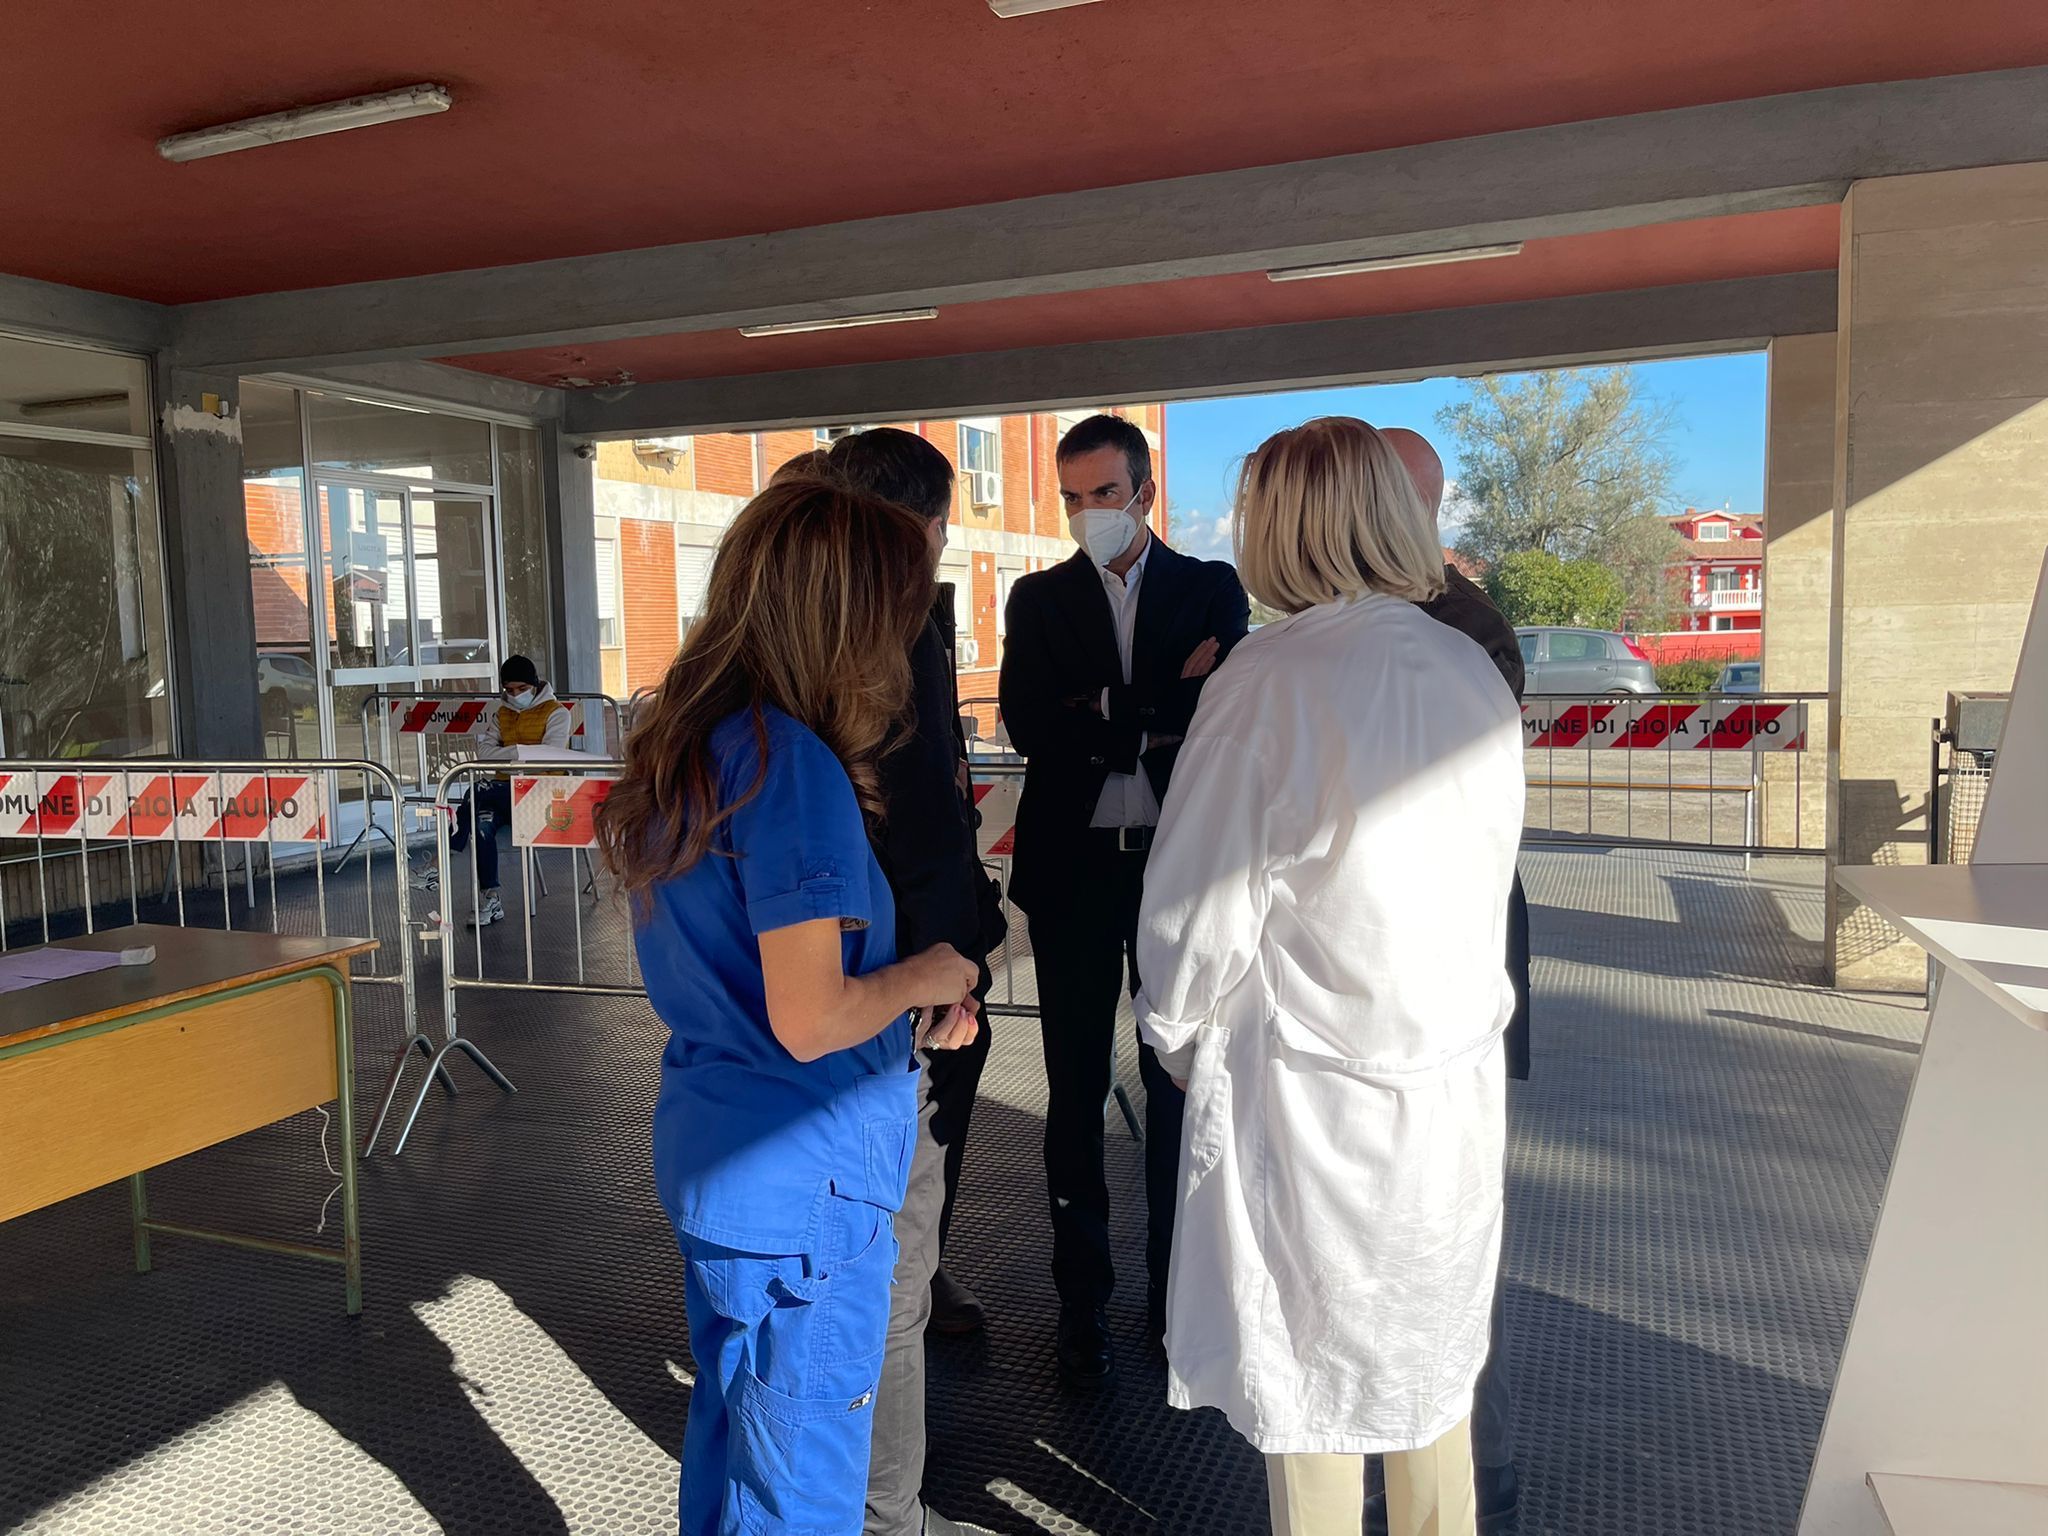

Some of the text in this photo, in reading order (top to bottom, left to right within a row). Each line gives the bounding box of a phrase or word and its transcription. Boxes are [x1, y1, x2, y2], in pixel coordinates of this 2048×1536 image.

[1594, 719, 1614, 734] DI
[1699, 719, 1781, 735] TAURO
[87, 797, 112, 816] DI
[207, 796, 299, 818] TAURO
